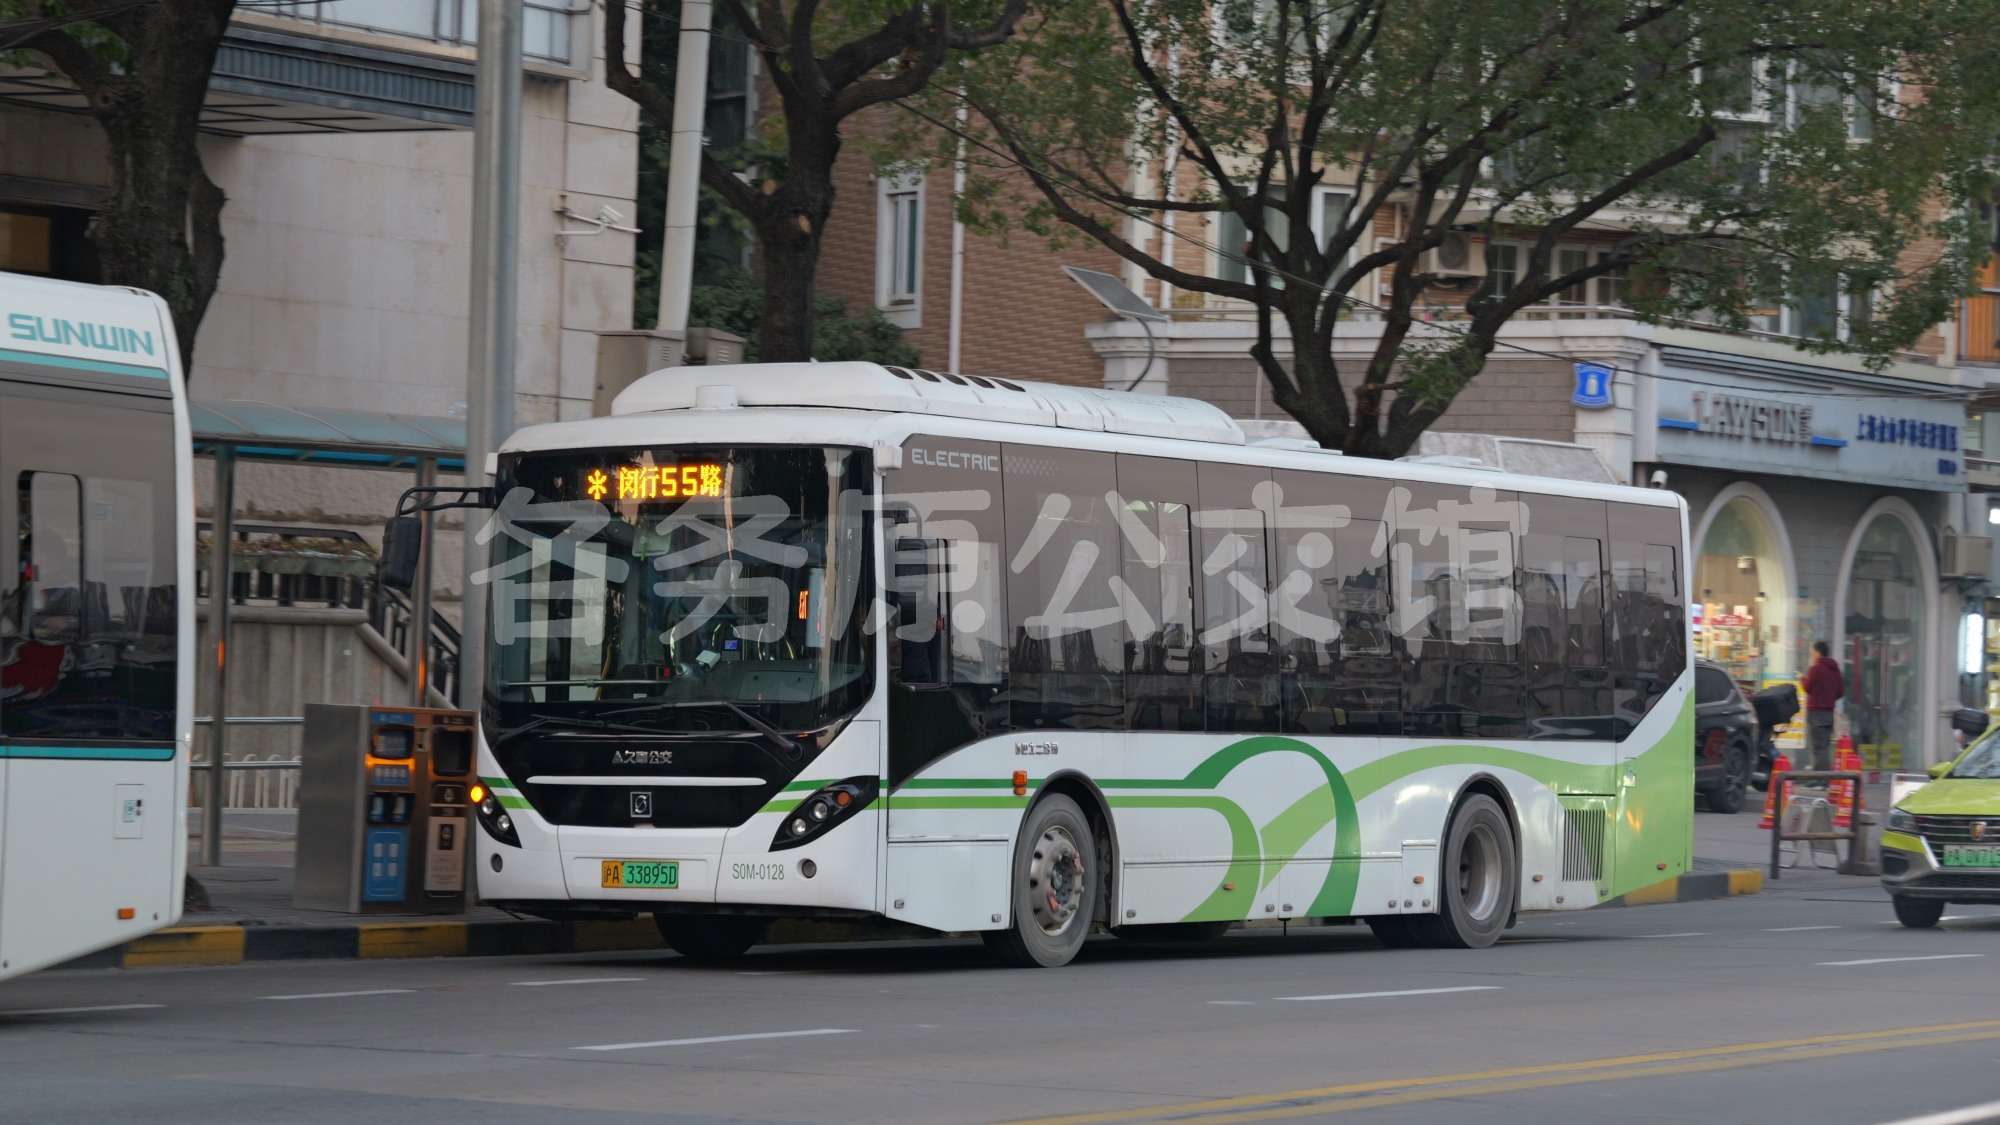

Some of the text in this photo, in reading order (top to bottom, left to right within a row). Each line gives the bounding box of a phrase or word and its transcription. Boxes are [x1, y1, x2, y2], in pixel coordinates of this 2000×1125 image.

[8, 313, 155, 356] SUNWIN
[1692, 390, 1800, 443] LAWSON
[911, 448, 1000, 472] ELECTRIC
[619, 464, 722, 499] 闵行55路
